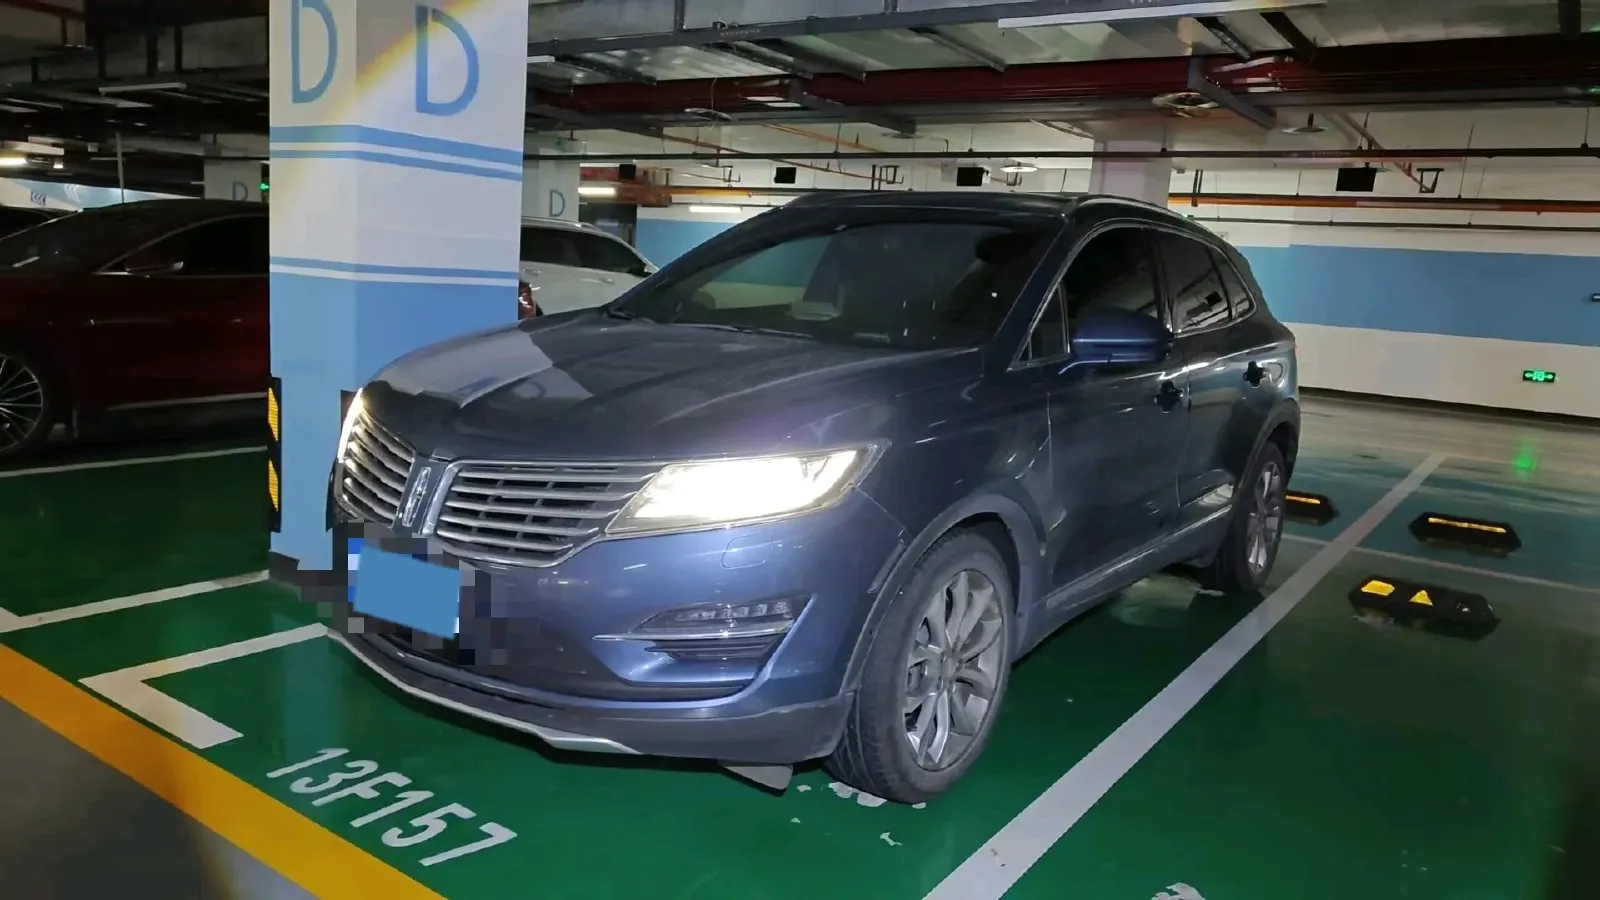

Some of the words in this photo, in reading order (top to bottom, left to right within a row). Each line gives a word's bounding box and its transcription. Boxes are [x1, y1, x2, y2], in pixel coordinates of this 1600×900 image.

[291, 0, 338, 104] D
[415, 5, 480, 116] D
[232, 181, 248, 200] D
[550, 188, 565, 217] D
[266, 748, 518, 866] 13F157
